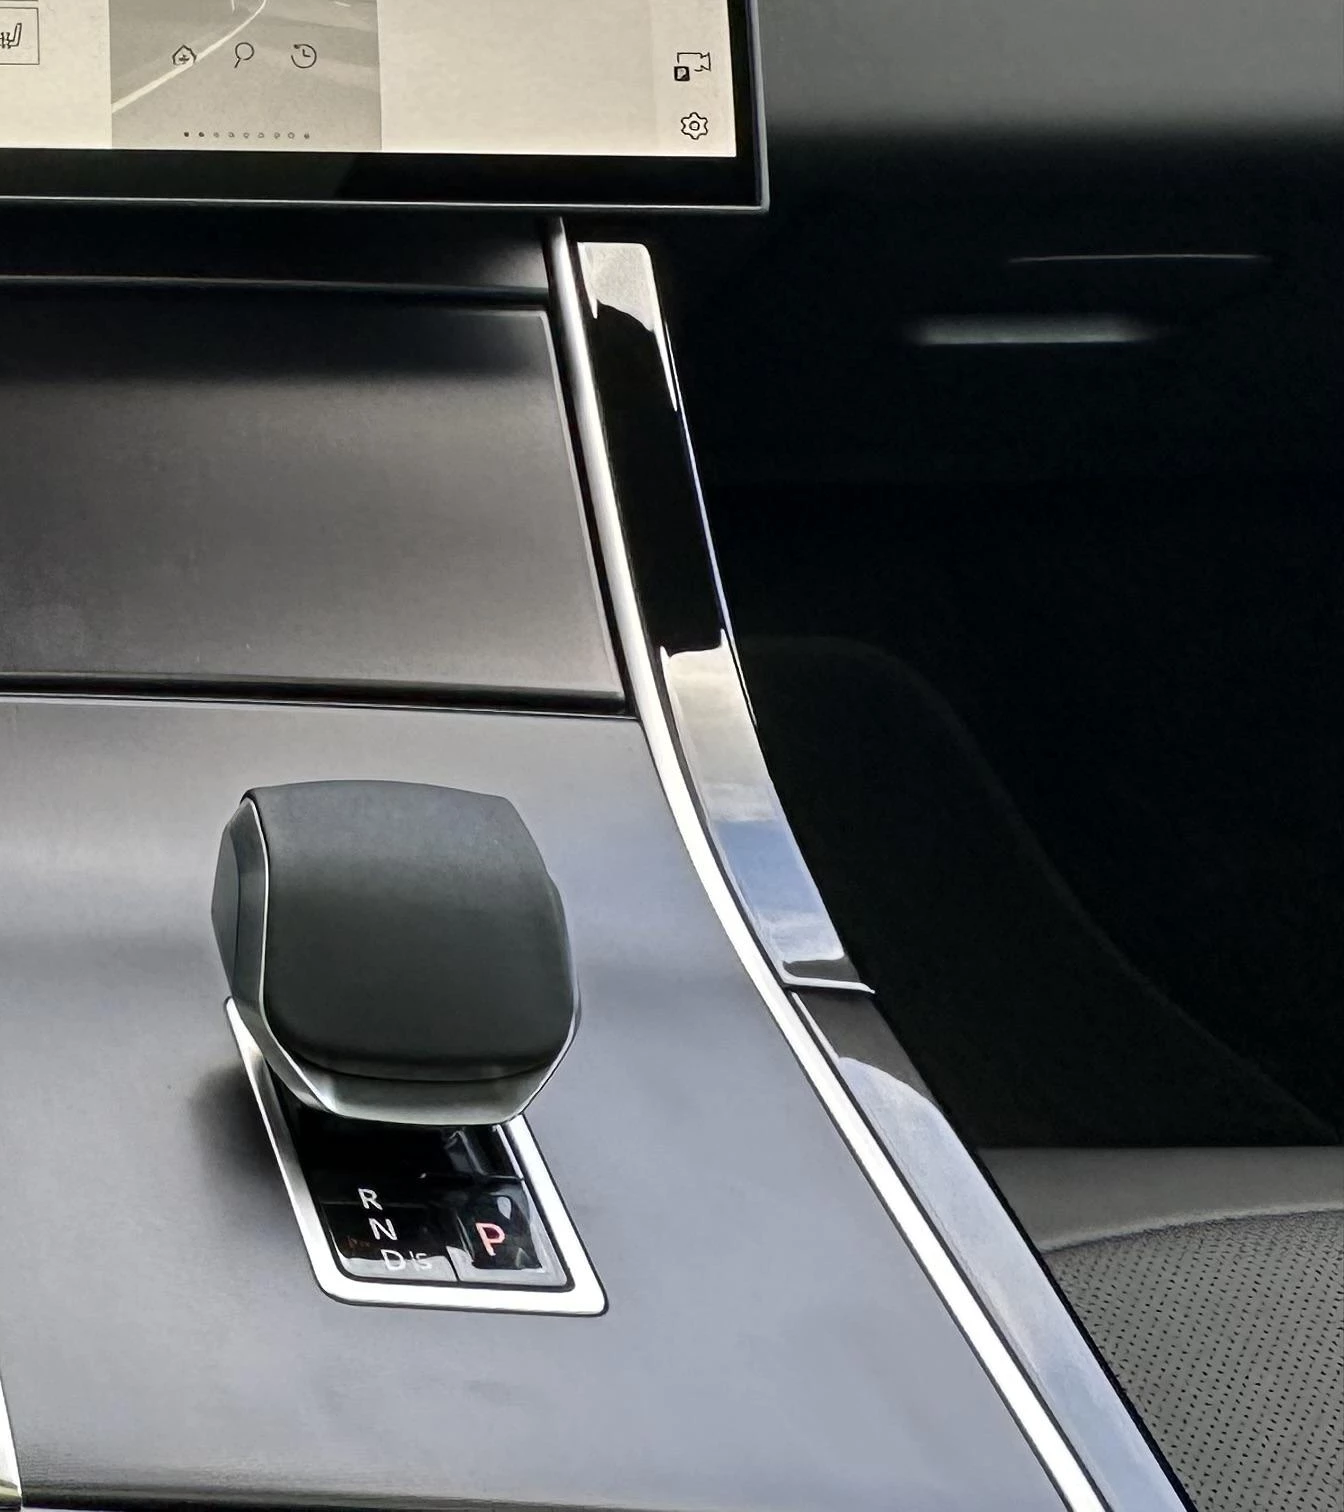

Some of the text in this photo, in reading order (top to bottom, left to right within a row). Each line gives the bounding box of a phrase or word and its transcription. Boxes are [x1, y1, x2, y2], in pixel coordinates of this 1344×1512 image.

[357, 1187, 384, 1211] R
[368, 1218, 398, 1241] N
[475, 1222, 506, 1257] P
[380, 1249, 407, 1272] D
